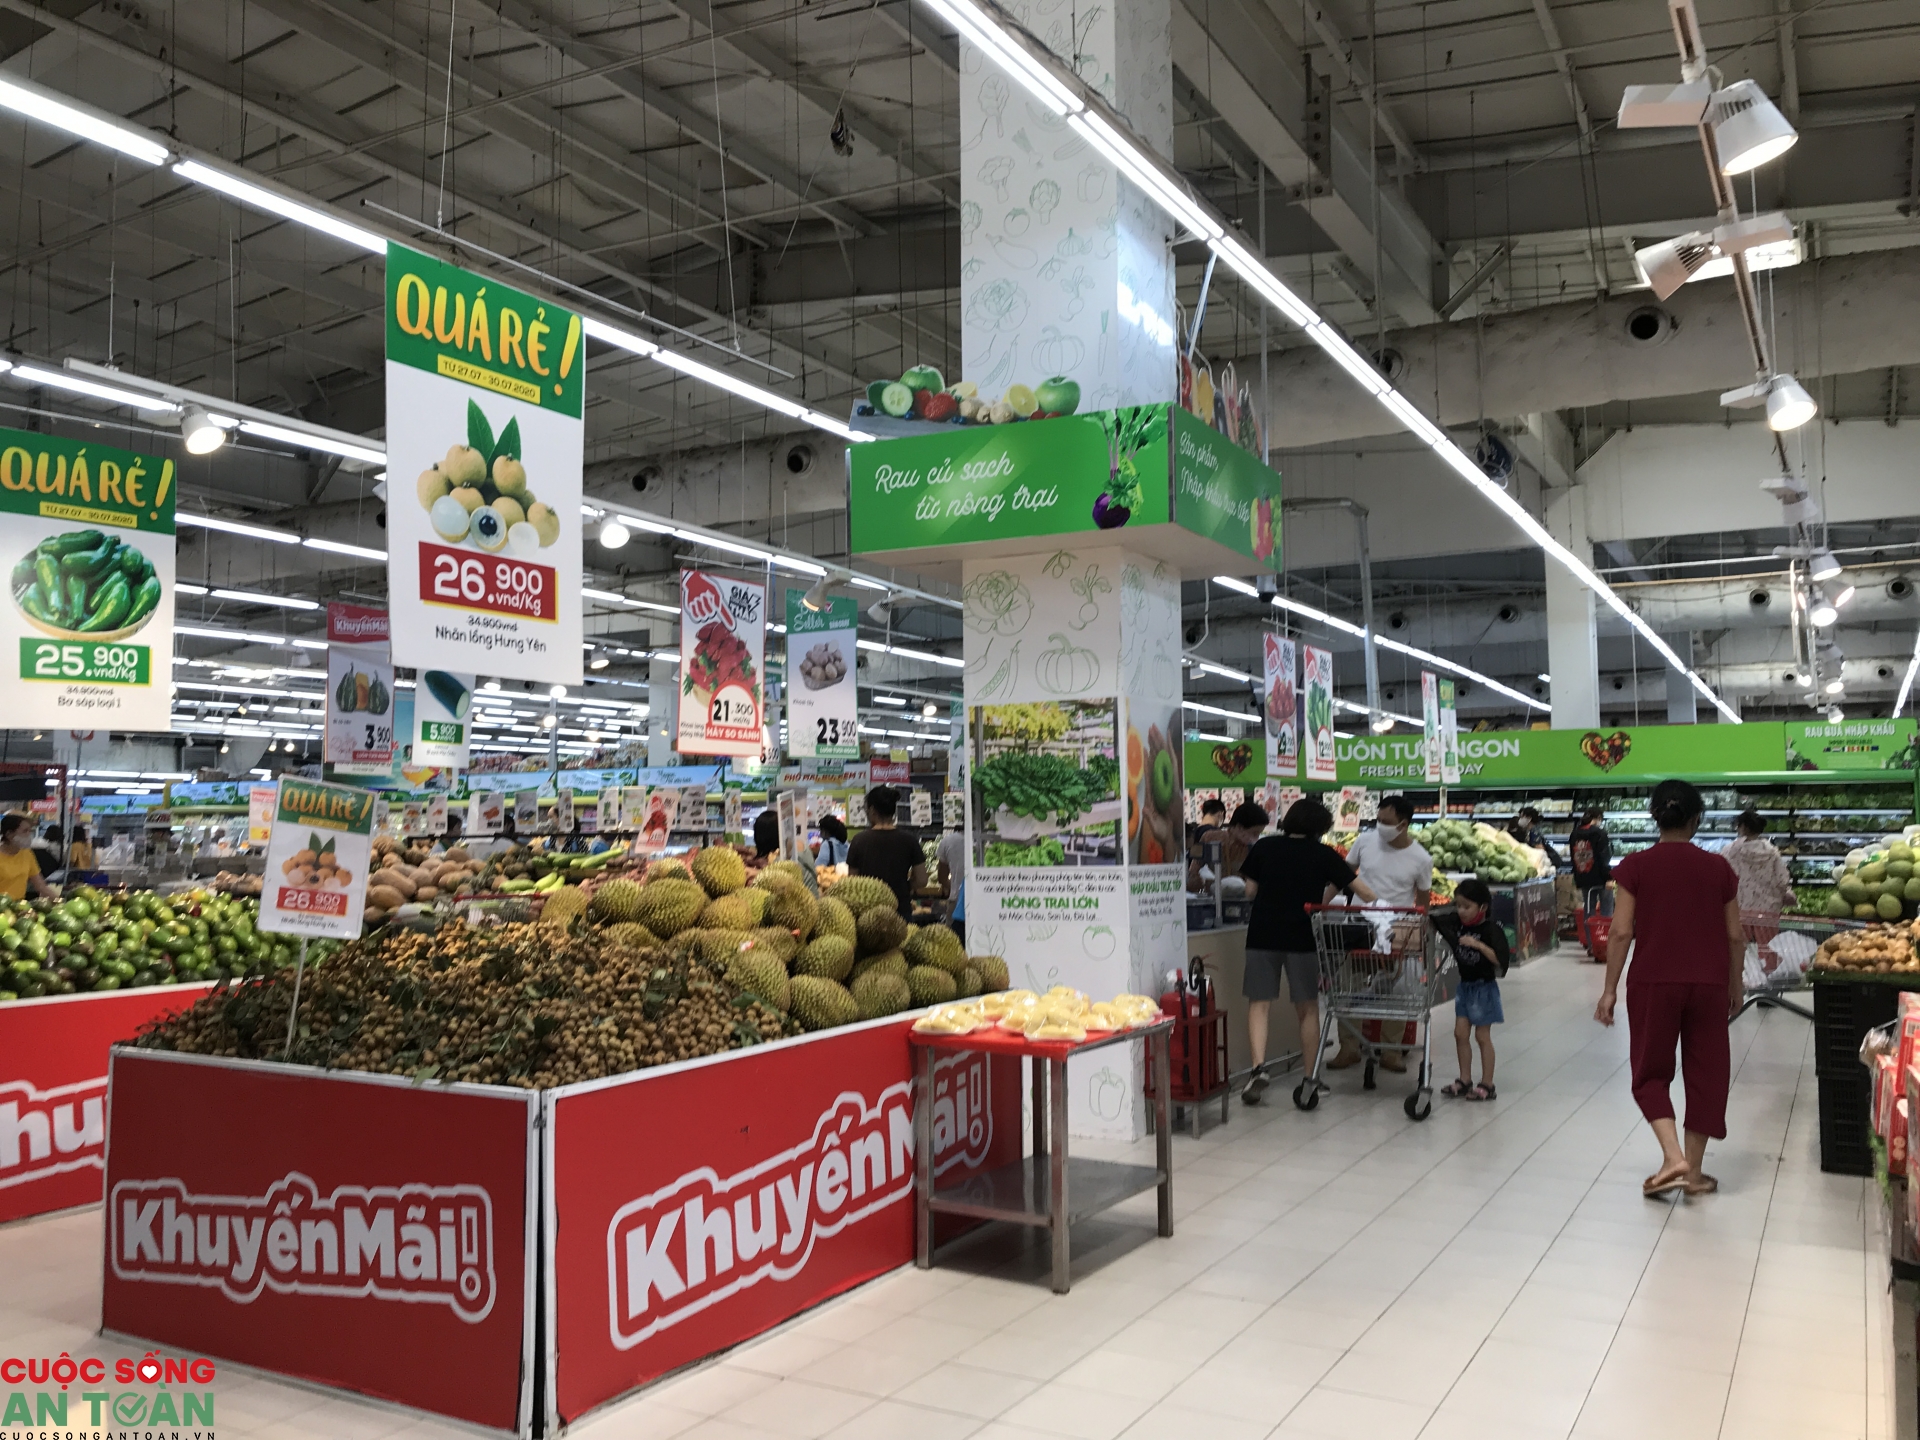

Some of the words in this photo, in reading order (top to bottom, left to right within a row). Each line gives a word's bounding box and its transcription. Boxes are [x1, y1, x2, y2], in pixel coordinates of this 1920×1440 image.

[396, 273, 492, 361] QUÁ
[0, 447, 92, 502] QUÁ
[875, 464, 920, 494] Rau
[927, 457, 954, 485] củ
[960, 451, 1015, 483] sạch
[915, 496, 941, 520] từ
[946, 494, 1005, 522] nông
[1011, 485, 1059, 512] trại
[1805, 725, 1822, 738] RAU
[1335, 739, 1386, 761] UÔN
[1359, 764, 1404, 777] FRESH
[1408, 762, 1484, 777] EVDAY
[282, 786, 328, 817] QUÁ
[1001, 894, 1041, 909] NÔNG
[1072, 894, 1099, 909] LỚN
[0, 1096, 107, 1170] hu
